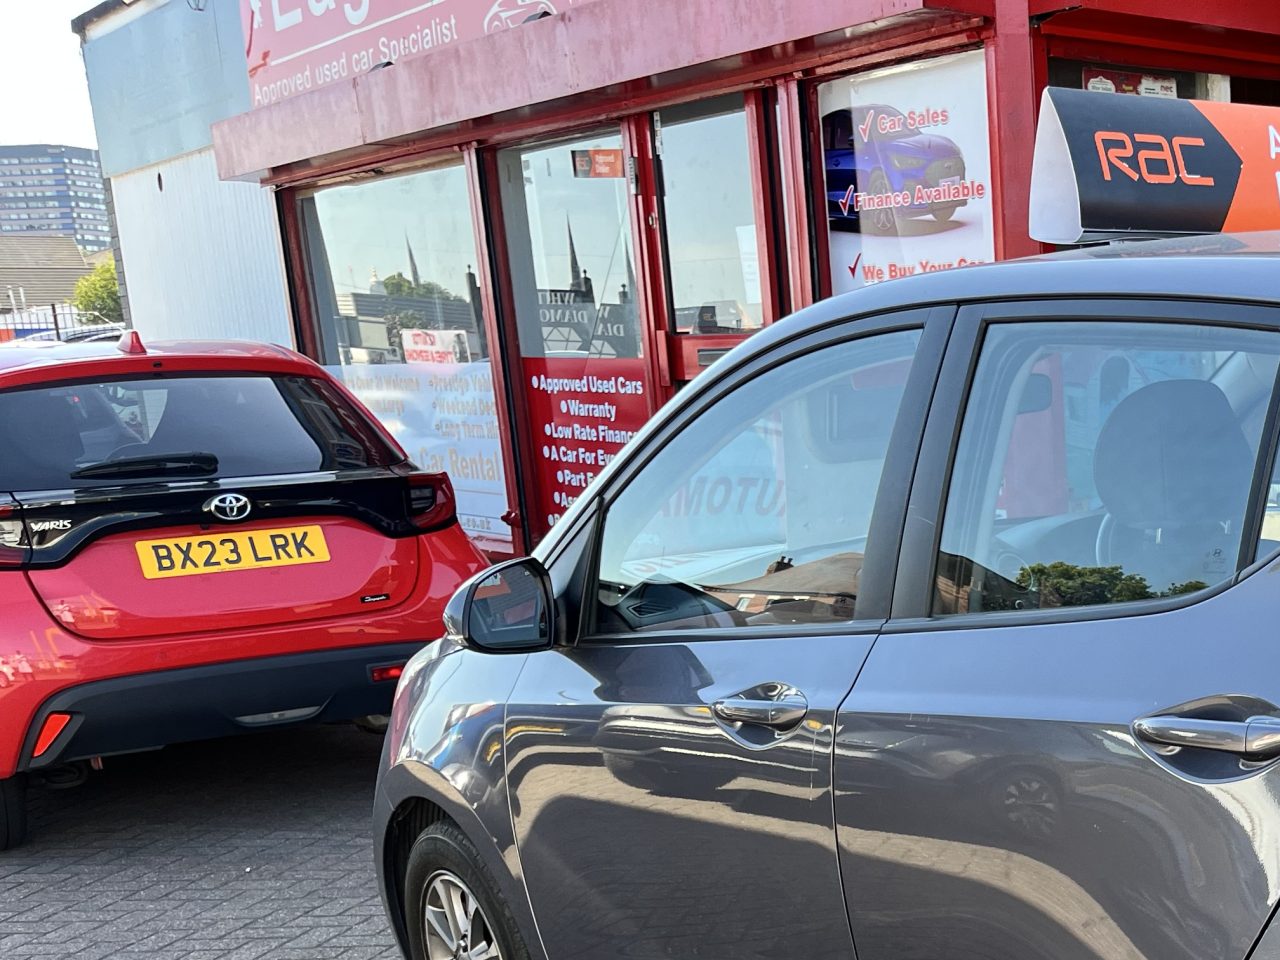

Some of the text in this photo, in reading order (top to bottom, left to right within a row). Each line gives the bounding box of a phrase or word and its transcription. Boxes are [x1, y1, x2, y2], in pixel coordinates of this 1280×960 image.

[253, 71, 312, 107] Approved
[315, 53, 346, 85] used
[352, 48, 375, 73] car
[876, 107, 949, 133] Car Sales
[1094, 131, 1215, 185] RAC
[854, 180, 986, 212] Finance Available
[862, 263, 884, 282] We
[540, 374, 644, 395] Approved Used Cars
[567, 400, 616, 421] Warranty
[551, 422, 572, 440] Low
[574, 423, 597, 442] Rate
[448, 447, 501, 482] Rental
[551, 446, 559, 461] A
[559, 446, 577, 463] Car
[579, 448, 596, 465] For
[564, 469, 586, 487] Part
[30, 519, 72, 533] YARIS
[151, 531, 316, 572] BX23 LRK
